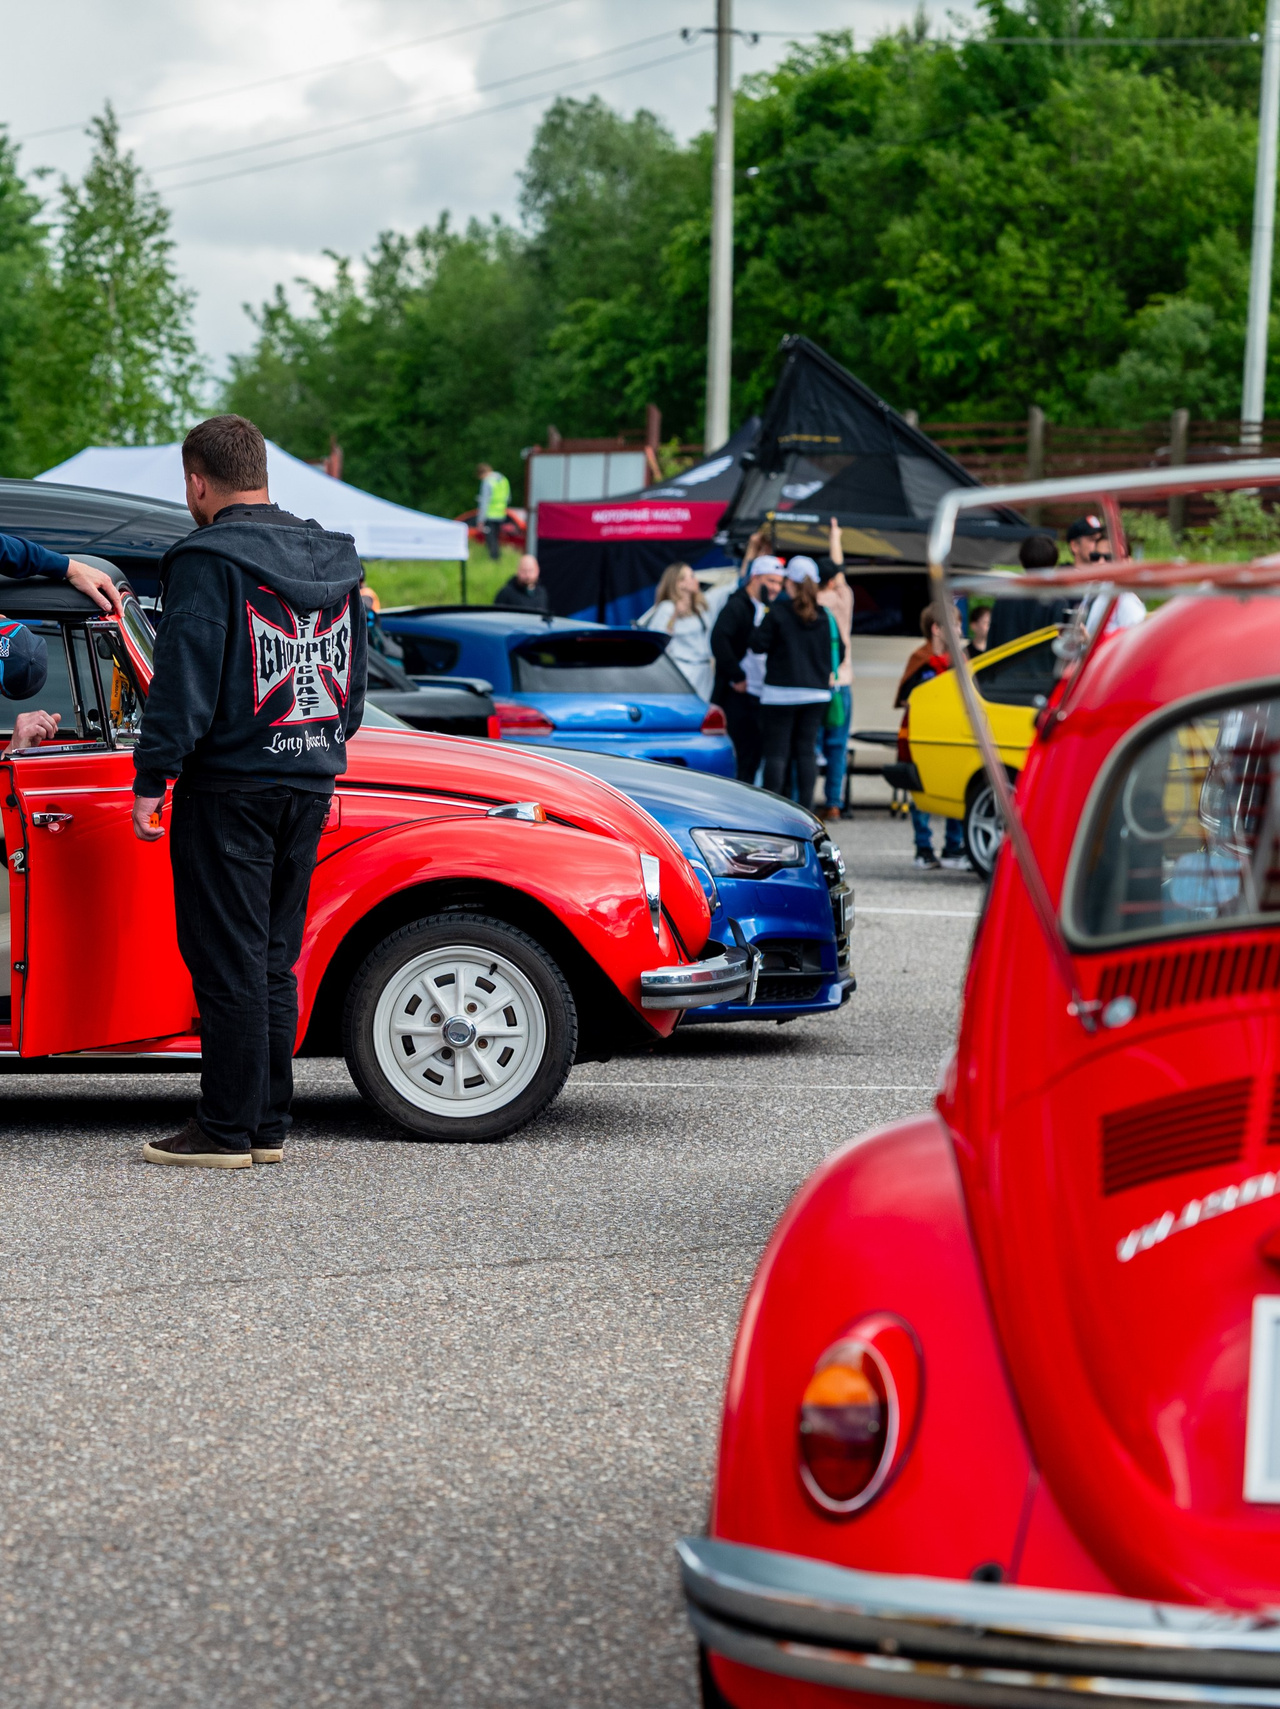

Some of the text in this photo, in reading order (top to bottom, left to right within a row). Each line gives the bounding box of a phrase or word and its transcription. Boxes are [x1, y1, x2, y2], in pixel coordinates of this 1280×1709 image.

[258, 622, 350, 683] CHOPPES
[296, 664, 320, 717] COAST
[263, 731, 303, 758] Long
